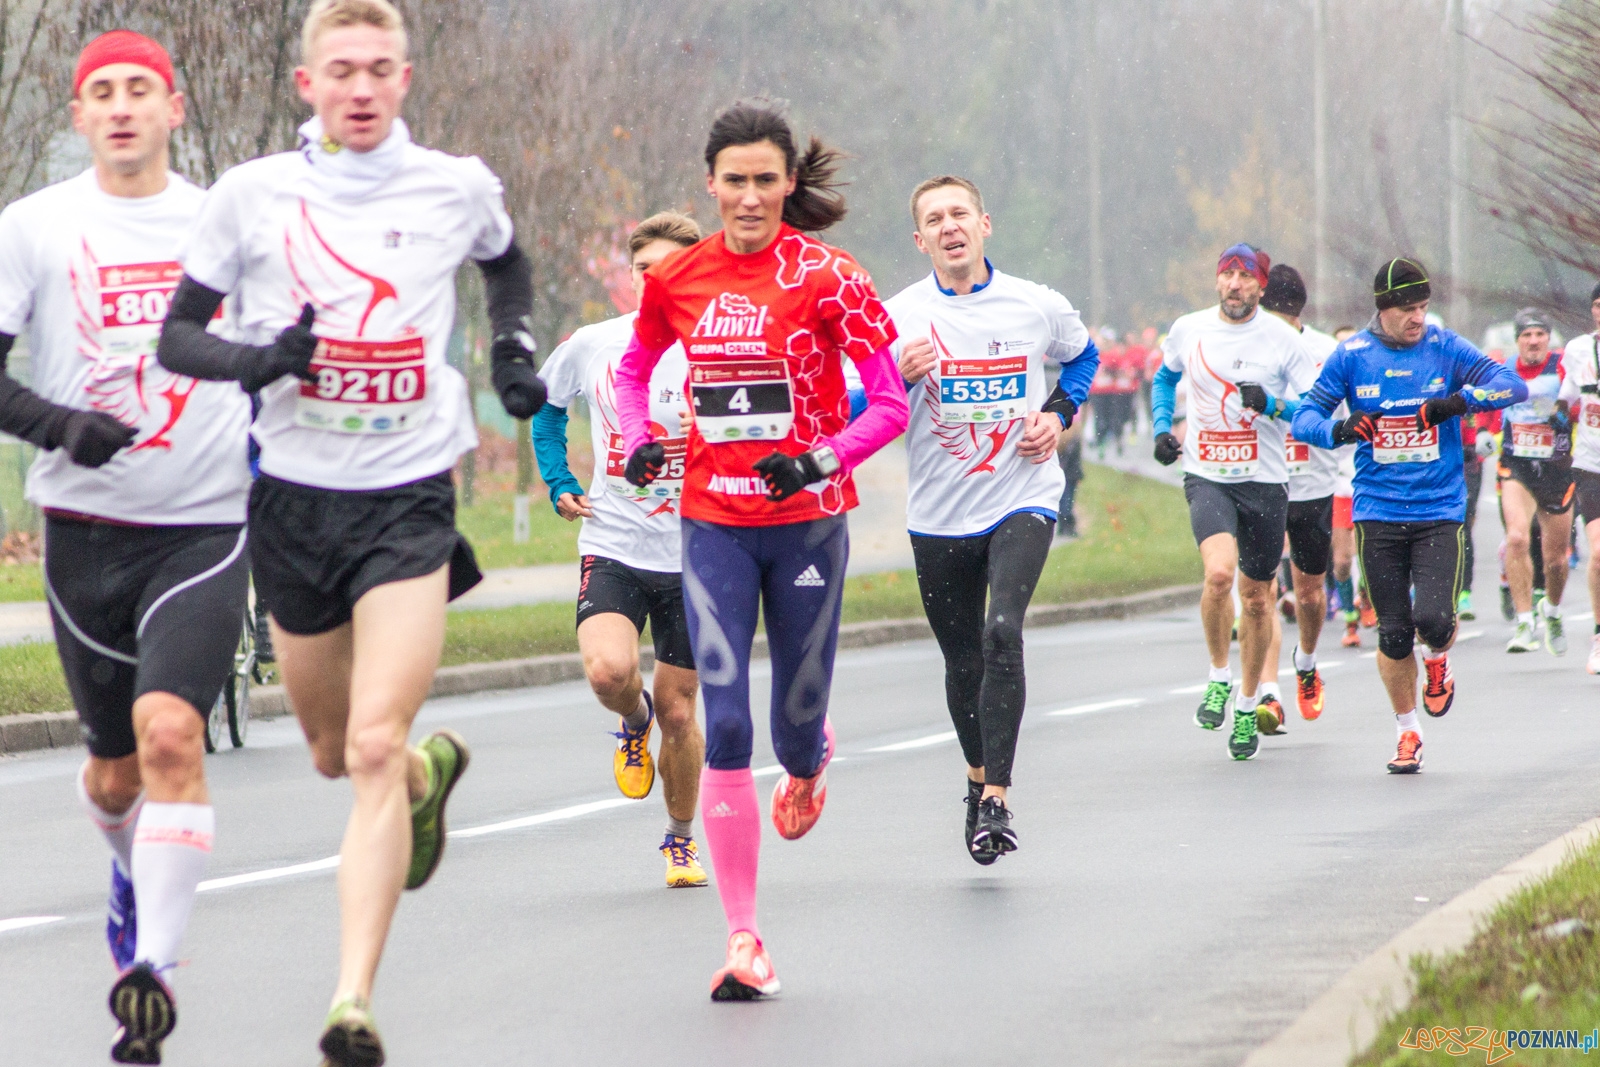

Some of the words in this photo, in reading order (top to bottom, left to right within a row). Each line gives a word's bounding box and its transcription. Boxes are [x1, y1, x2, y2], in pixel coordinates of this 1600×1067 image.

[116, 289, 177, 325] 80
[690, 298, 768, 337] Anwil
[690, 344, 724, 354] GRUPA
[728, 344, 764, 353] ORLEN
[317, 367, 419, 402] 9210
[942, 387, 950, 395] E
[952, 377, 1019, 402] 5354
[728, 387, 751, 413] 4
[1381, 430, 1433, 448] 3922
[1205, 444, 1252, 461] 3900
[793, 578, 825, 586] adidas
